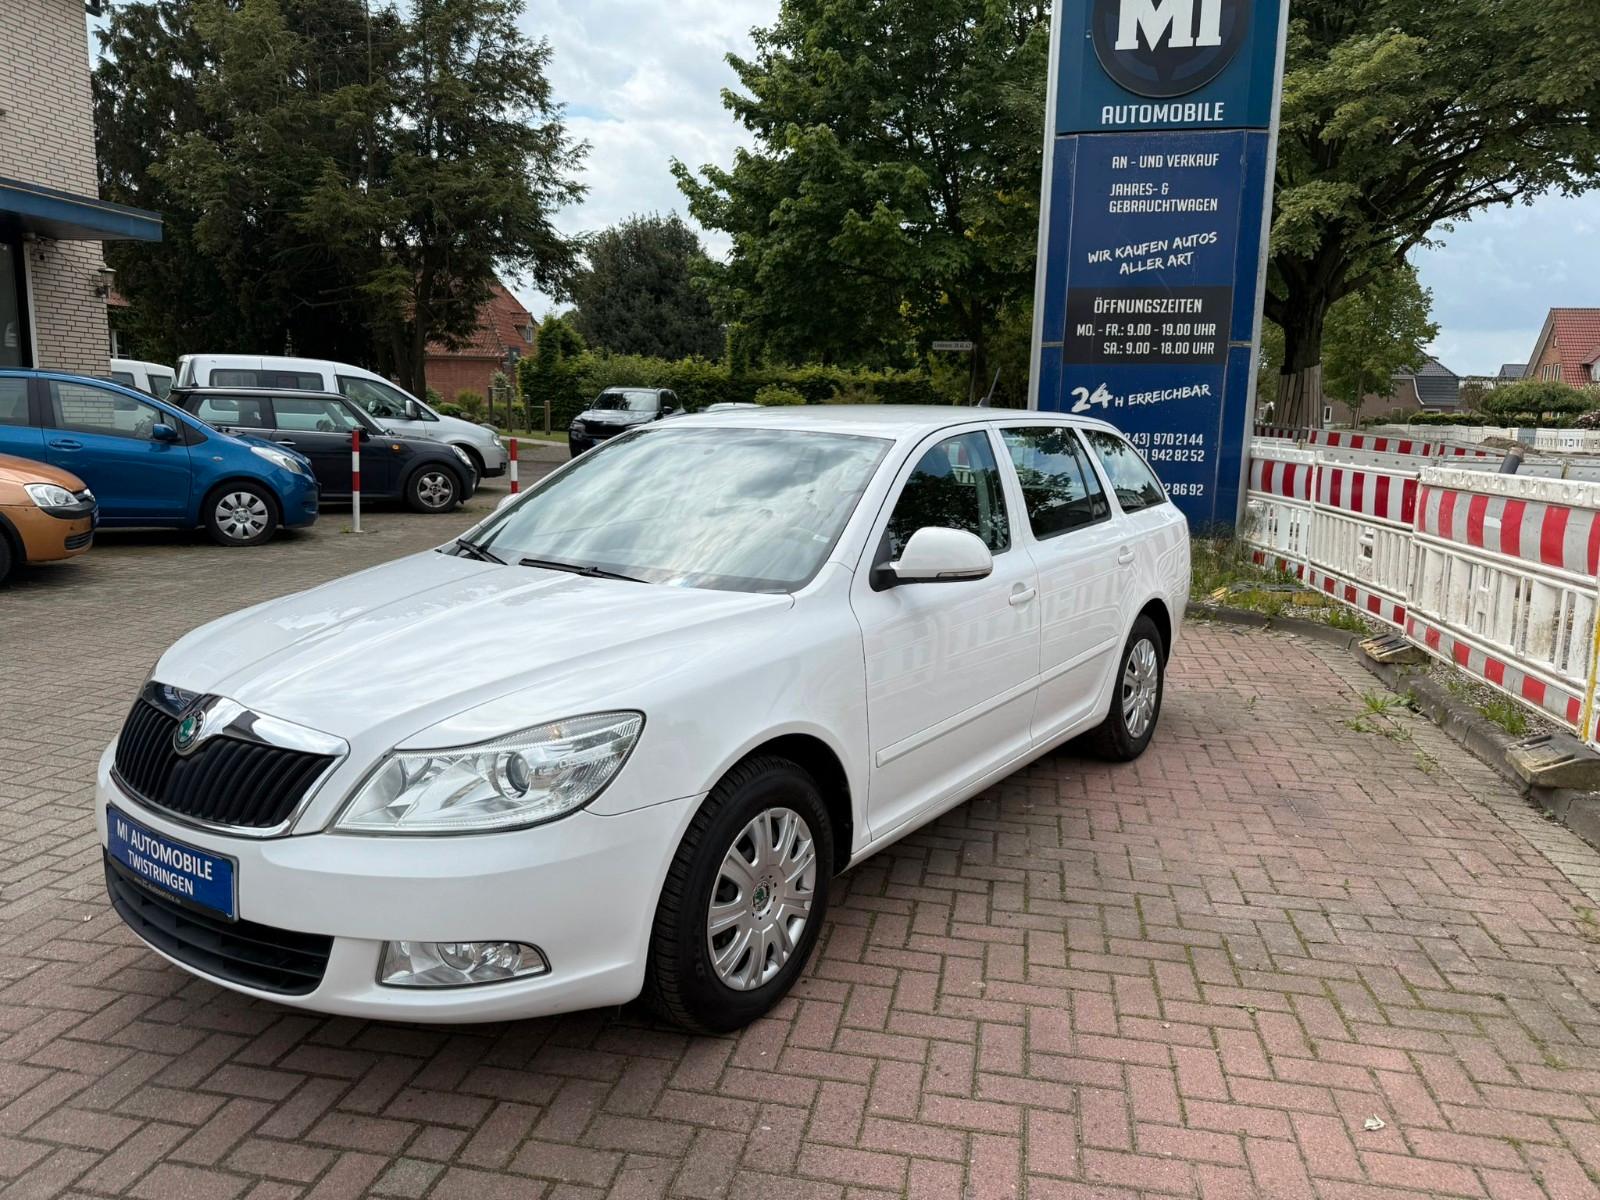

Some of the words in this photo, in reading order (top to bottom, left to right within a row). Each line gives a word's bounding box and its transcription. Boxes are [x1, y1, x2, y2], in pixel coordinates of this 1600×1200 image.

[1115, 0, 1221, 51] MI
[1102, 103, 1224, 124] AUTOMOBILE
[1113, 156, 1127, 168] AN
[1140, 155, 1163, 168] UND
[1167, 154, 1219, 167] VERKAUF
[1162, 183, 1168, 195] &
[1109, 199, 1217, 212] GEBRAUCHTWAGEN
[1088, 250, 1112, 263] WIR
[1115, 240, 1168, 259] KAUFEN
[1173, 232, 1217, 249] AUTOS
[1119, 257, 1164, 275] ALLER
[1167, 252, 1193, 267] ART
[1094, 297, 1202, 313] ÖFFNUNGSZEITEN
[1077, 324, 1095, 336] MO.
[1127, 324, 1151, 335] 9.00
[1163, 324, 1190, 335] 19.00
[1194, 324, 1215, 335] UHR
[1126, 342, 1149, 354] 9.00
[1161, 342, 1189, 354] 18.00
[1193, 342, 1214, 354] UHR
[1071, 382, 1113, 413] 24
[1115, 397, 1123, 407] H
[1129, 384, 1211, 405] ERREICHBAR
[117, 819, 127, 841] MI
[131, 829, 213, 881] AUTOMOBILE
[128, 850, 194, 896] TWISTRINGEN
